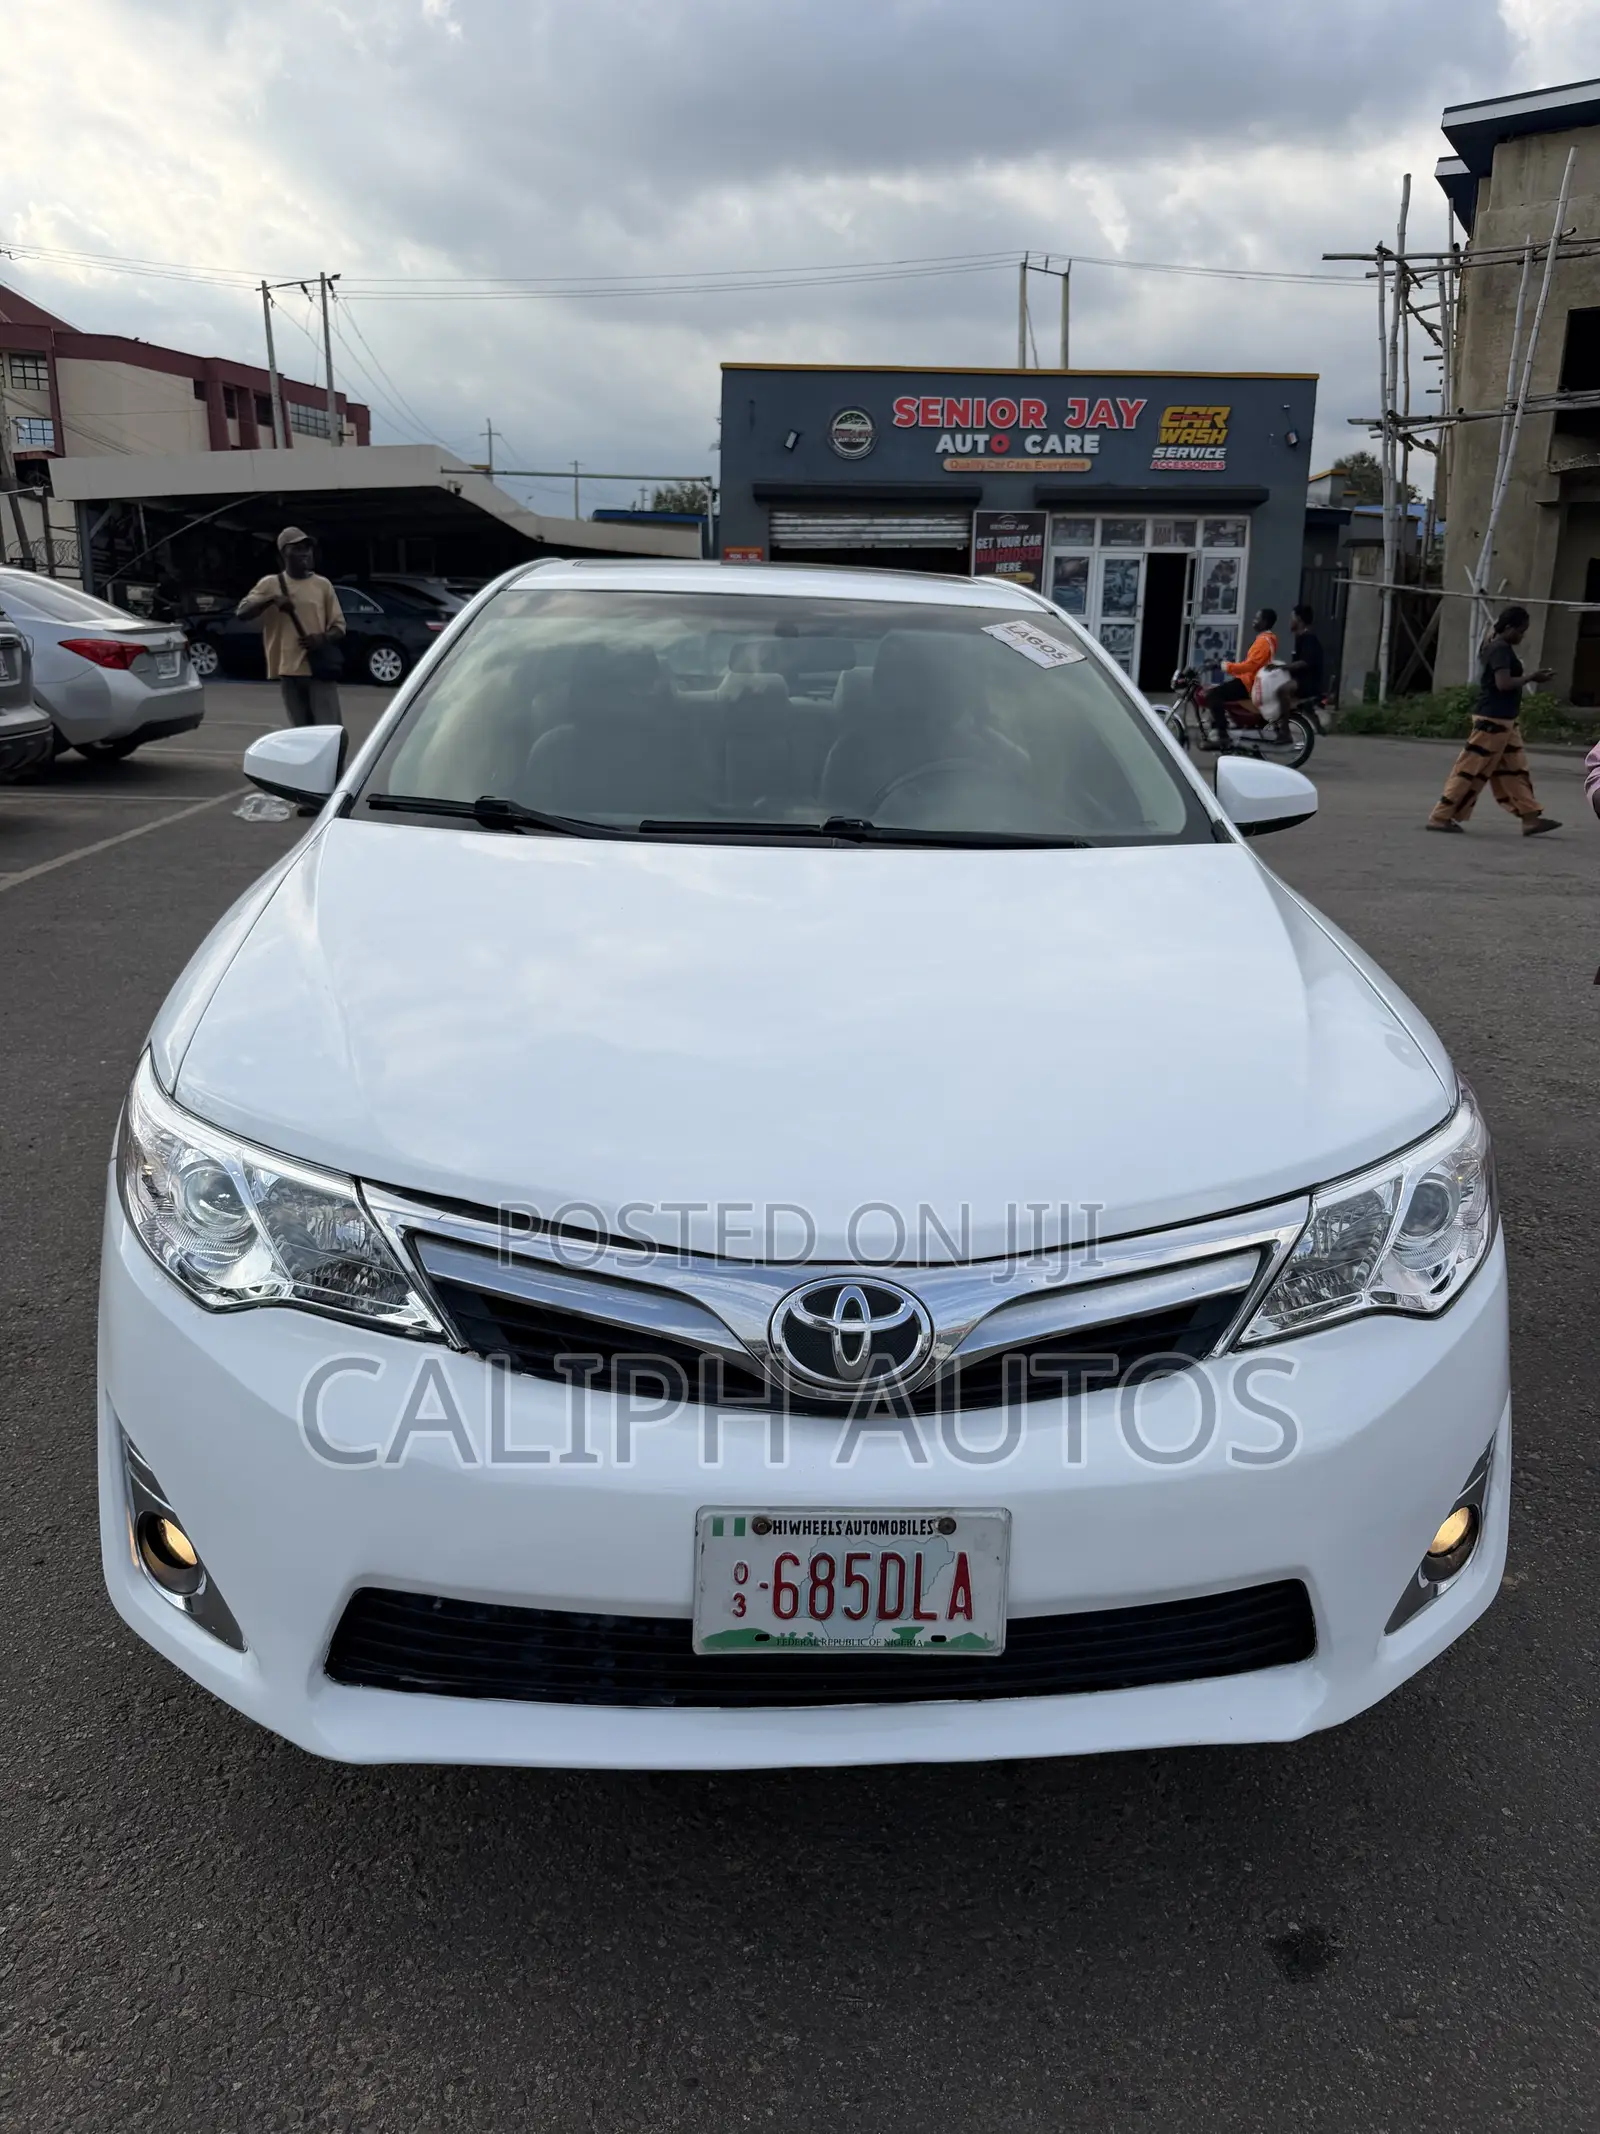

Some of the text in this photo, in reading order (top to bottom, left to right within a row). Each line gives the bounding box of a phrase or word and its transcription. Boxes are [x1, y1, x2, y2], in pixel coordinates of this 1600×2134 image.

[893, 397, 1147, 429] SENIOR JAY
[1161, 406, 1231, 428] CAR
[935, 434, 1100, 454] AUTO CARE
[1160, 428, 1228, 445] WASH
[1152, 447, 1227, 459] SERVICE
[1150, 460, 1226, 471] ACCESSORIES
[976, 534, 1042, 549] GET YOUR CAR
[995, 561, 1022, 573] HERE
[1006, 625, 1069, 661] LAGOS
[776, 1638, 924, 1647] FEDERAL REPUBLIC OF NIGERIA
